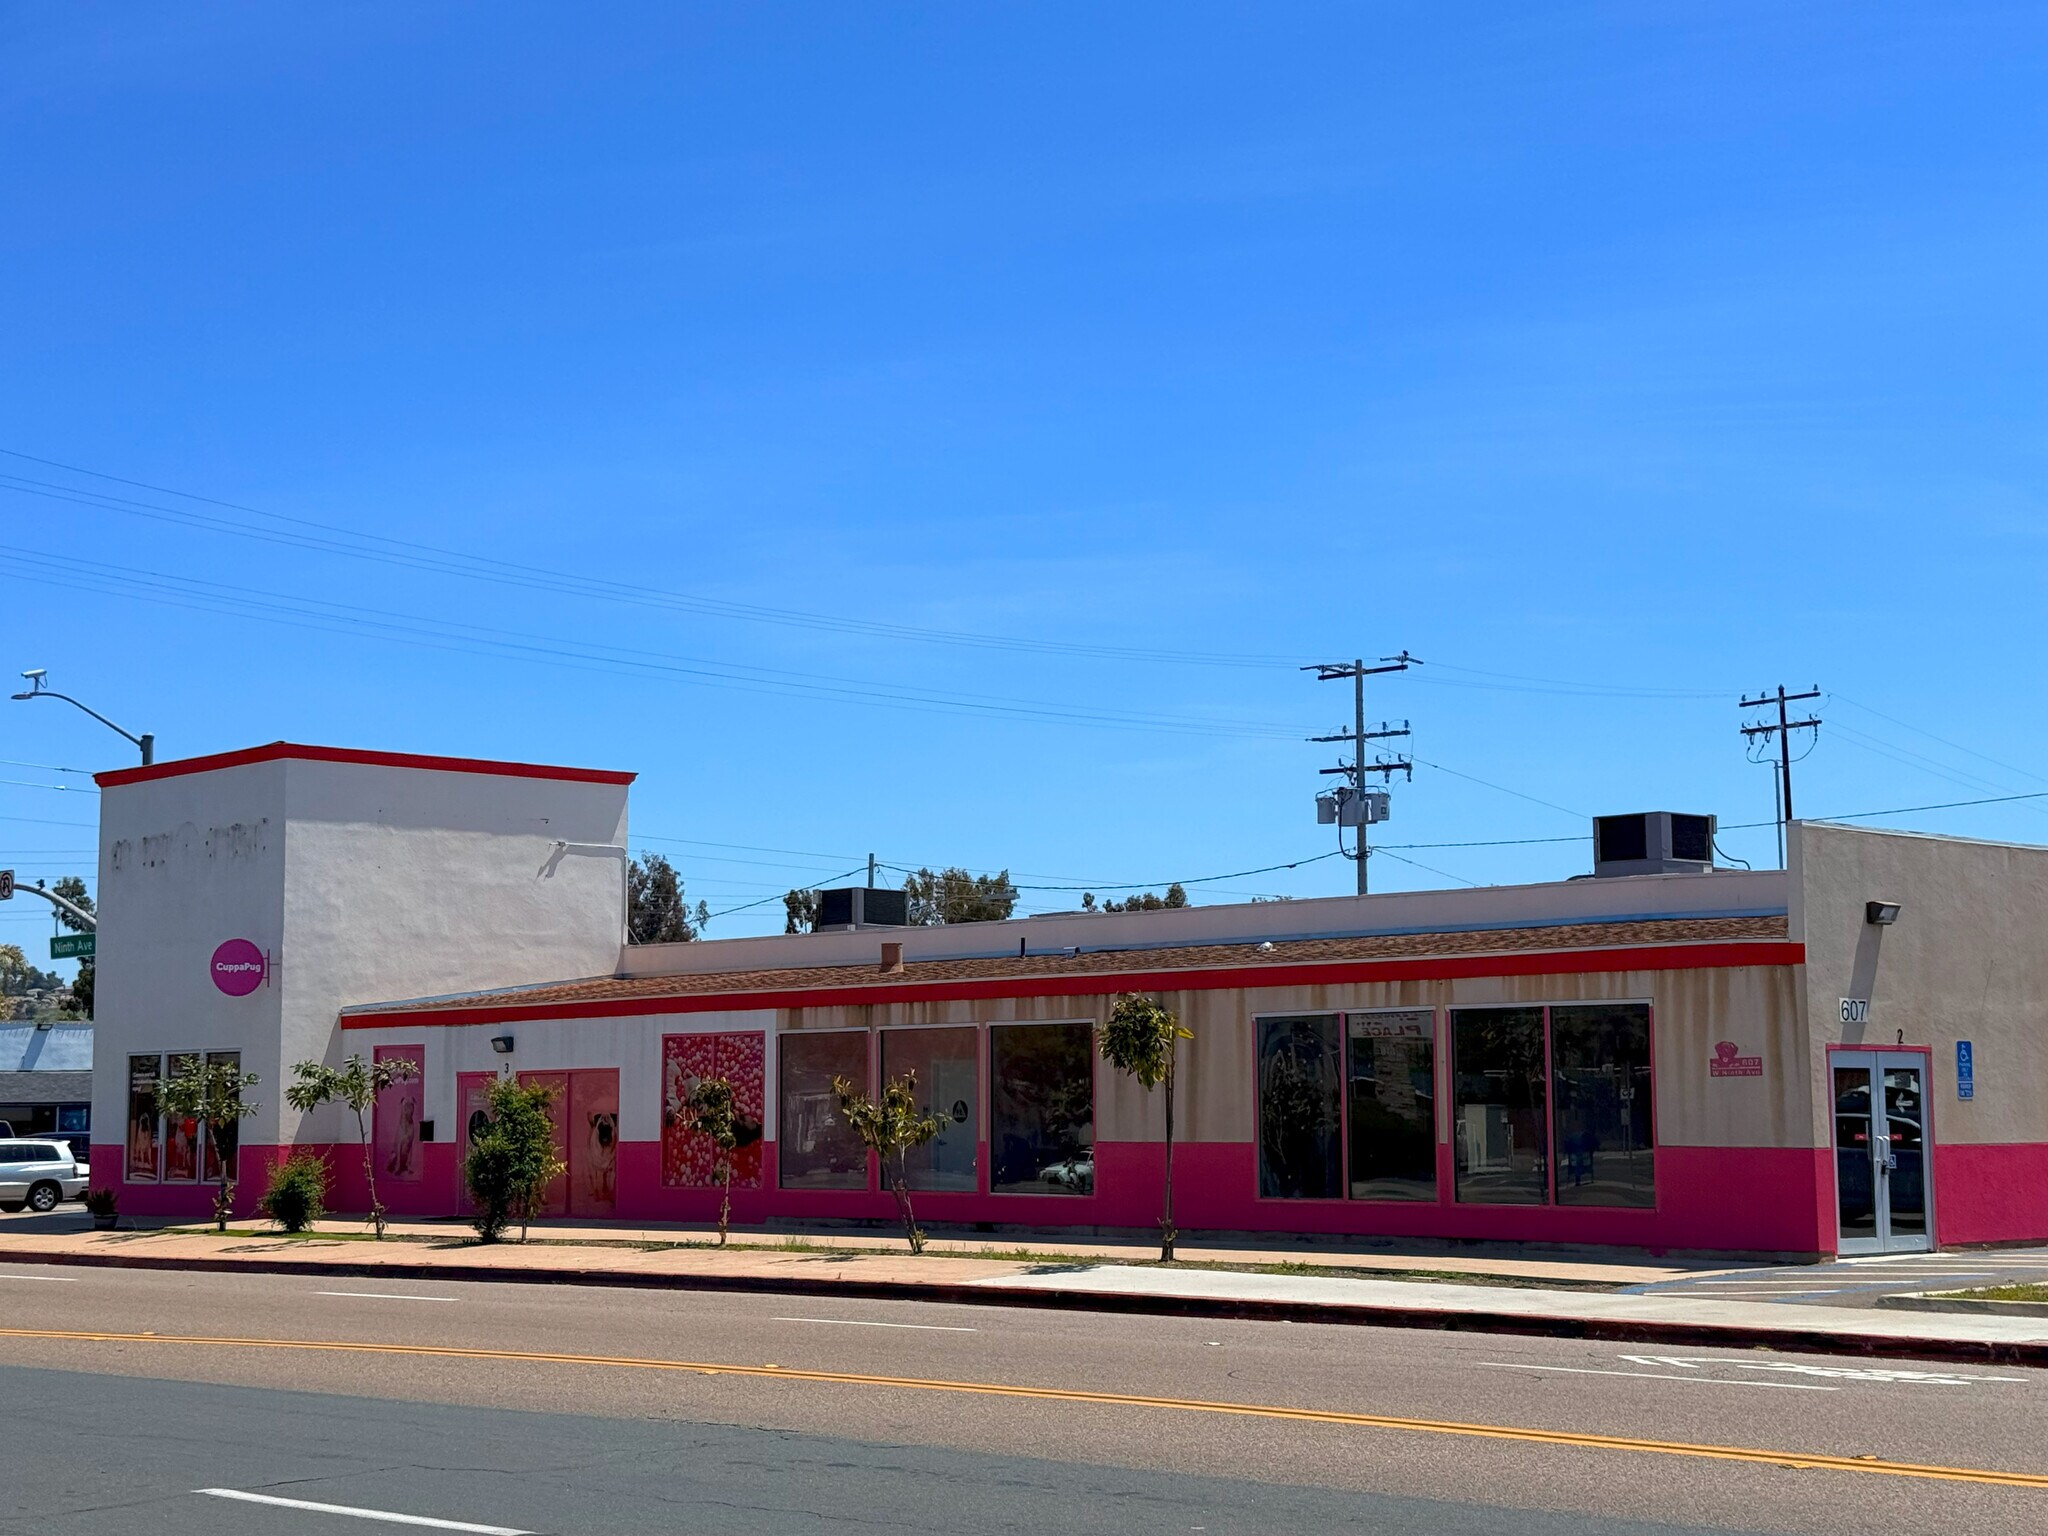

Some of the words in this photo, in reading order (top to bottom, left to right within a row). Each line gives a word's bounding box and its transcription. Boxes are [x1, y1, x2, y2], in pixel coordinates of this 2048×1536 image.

[54, 941, 75, 954] Ninth
[77, 940, 93, 951] Ave
[216, 962, 261, 973] CuppaPug
[1841, 1000, 1866, 1021] 607
[1897, 1028, 1904, 1044] 2
[504, 1063, 510, 1074] 3
